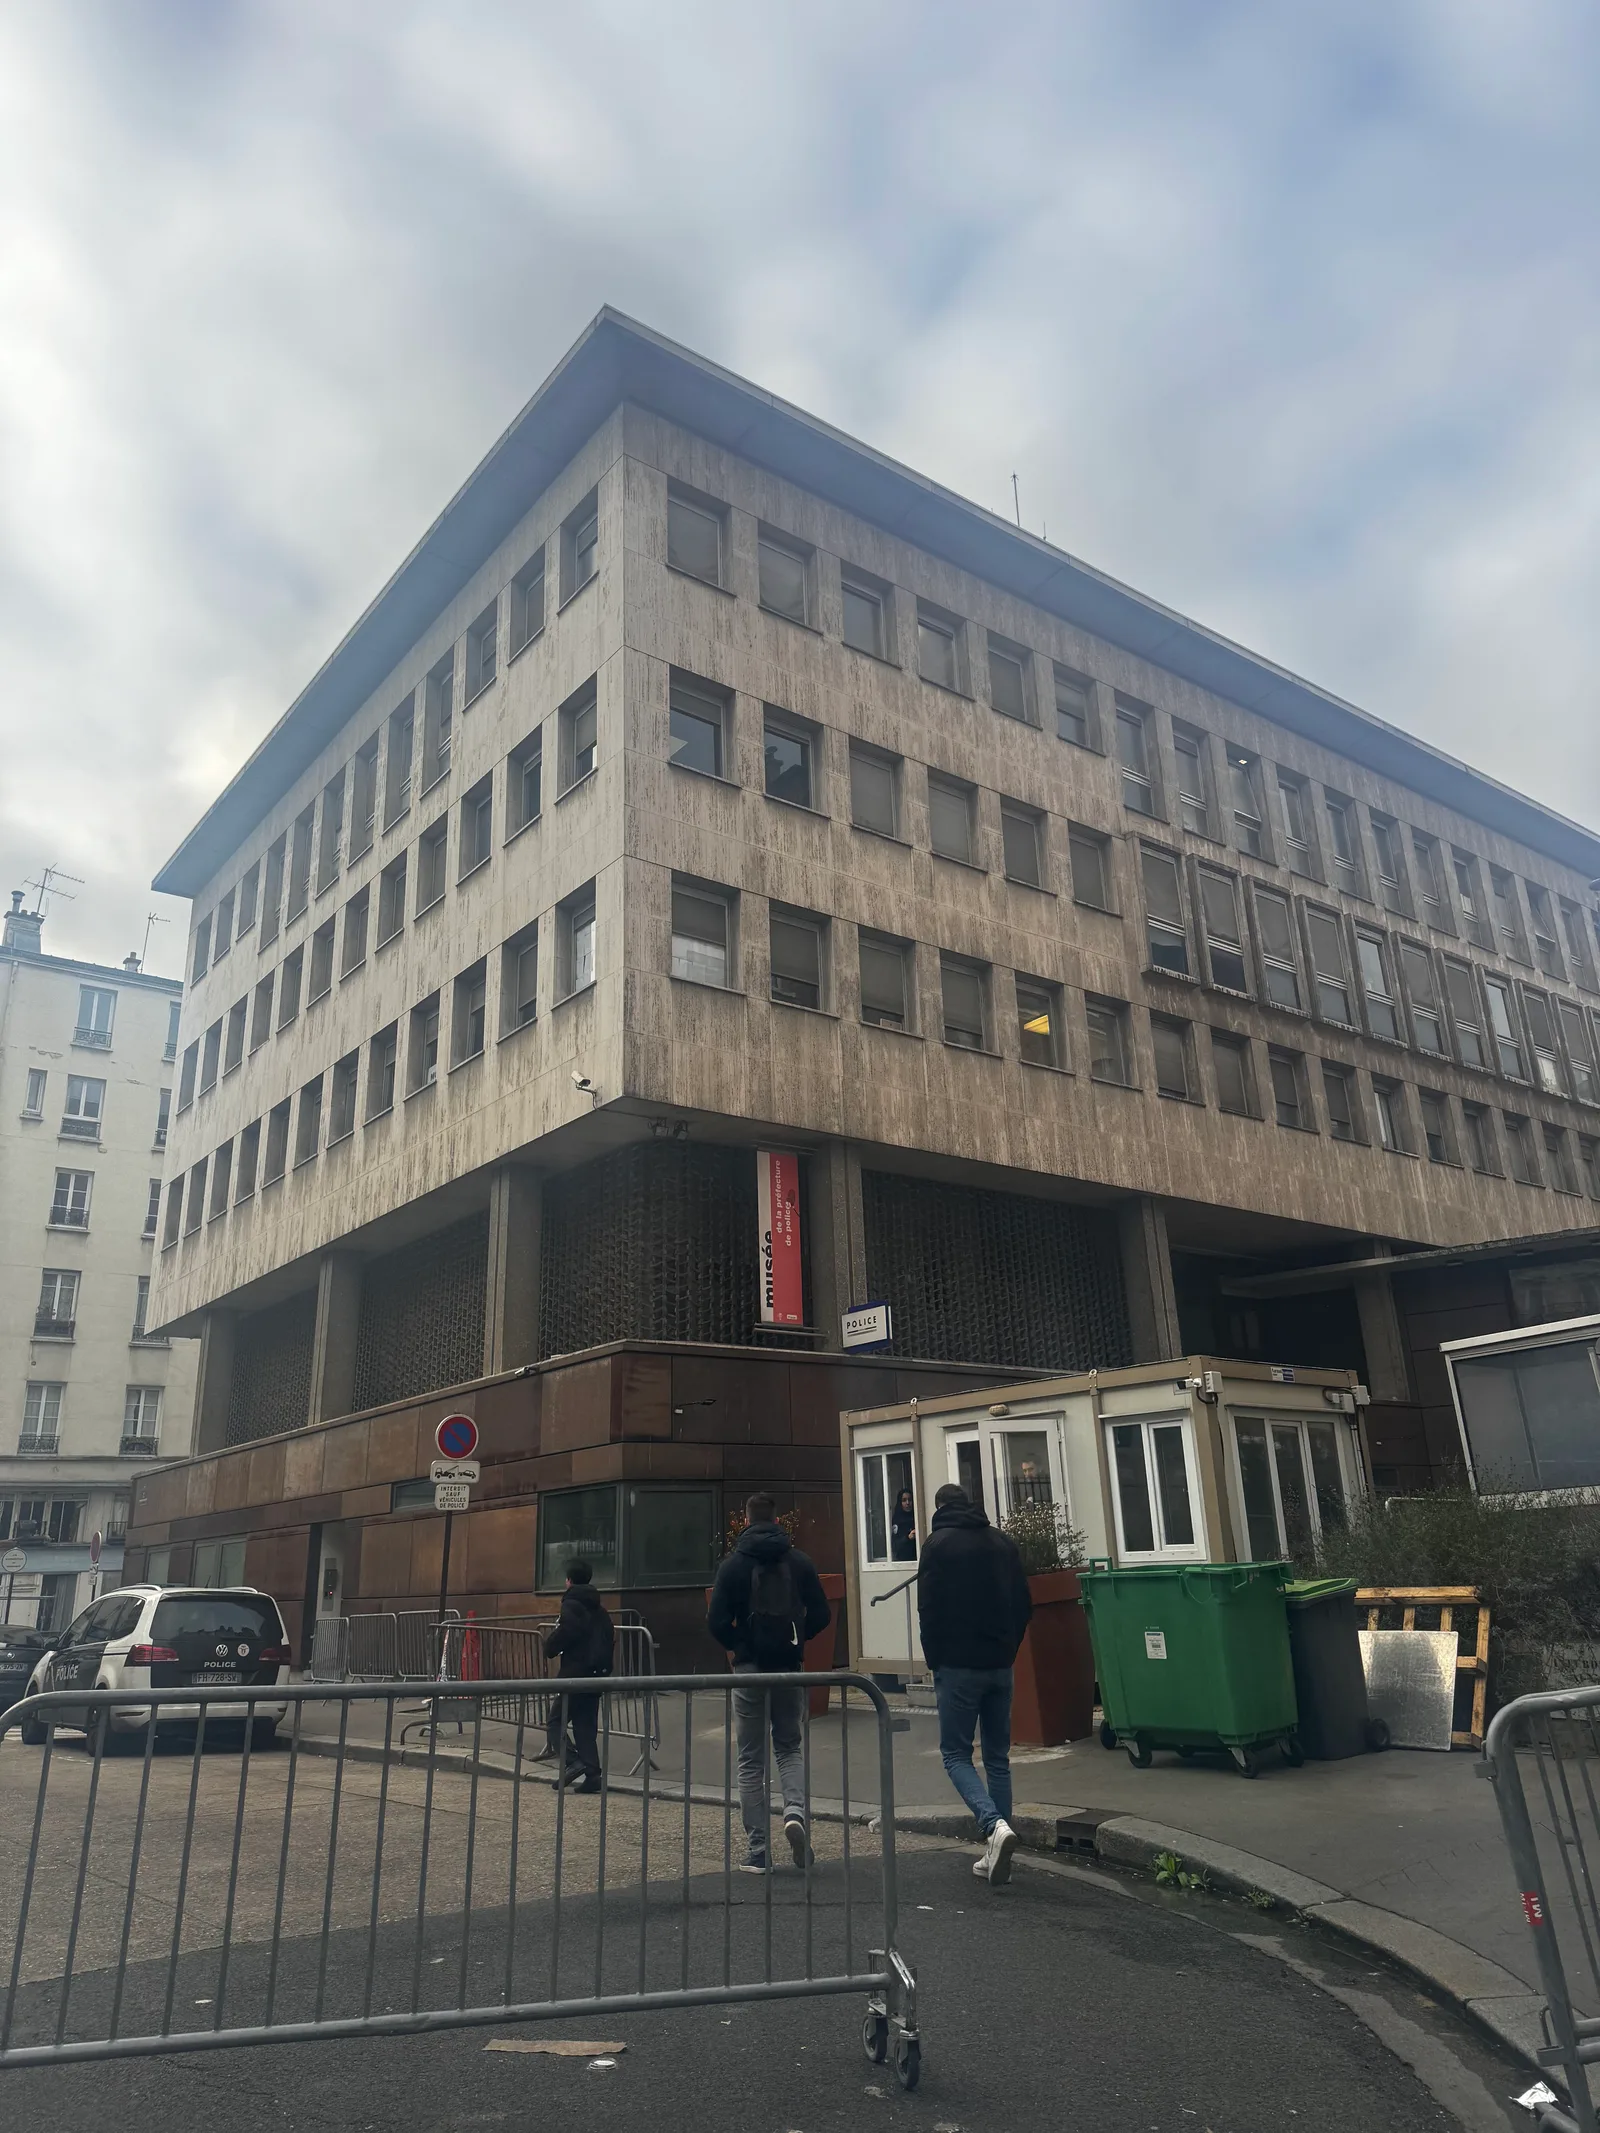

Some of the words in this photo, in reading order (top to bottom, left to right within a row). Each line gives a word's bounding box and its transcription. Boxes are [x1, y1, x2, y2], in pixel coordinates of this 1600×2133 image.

[775, 1160, 783, 1208] préfecture
[776, 1211, 782, 1219] la
[784, 1201, 793, 1232] police
[776, 1221, 783, 1233] de
[785, 1234, 792, 1246] de
[761, 1230, 774, 1308] musée
[846, 1315, 877, 1329] POLICE
[56, 1664, 79, 1681] POLICE
